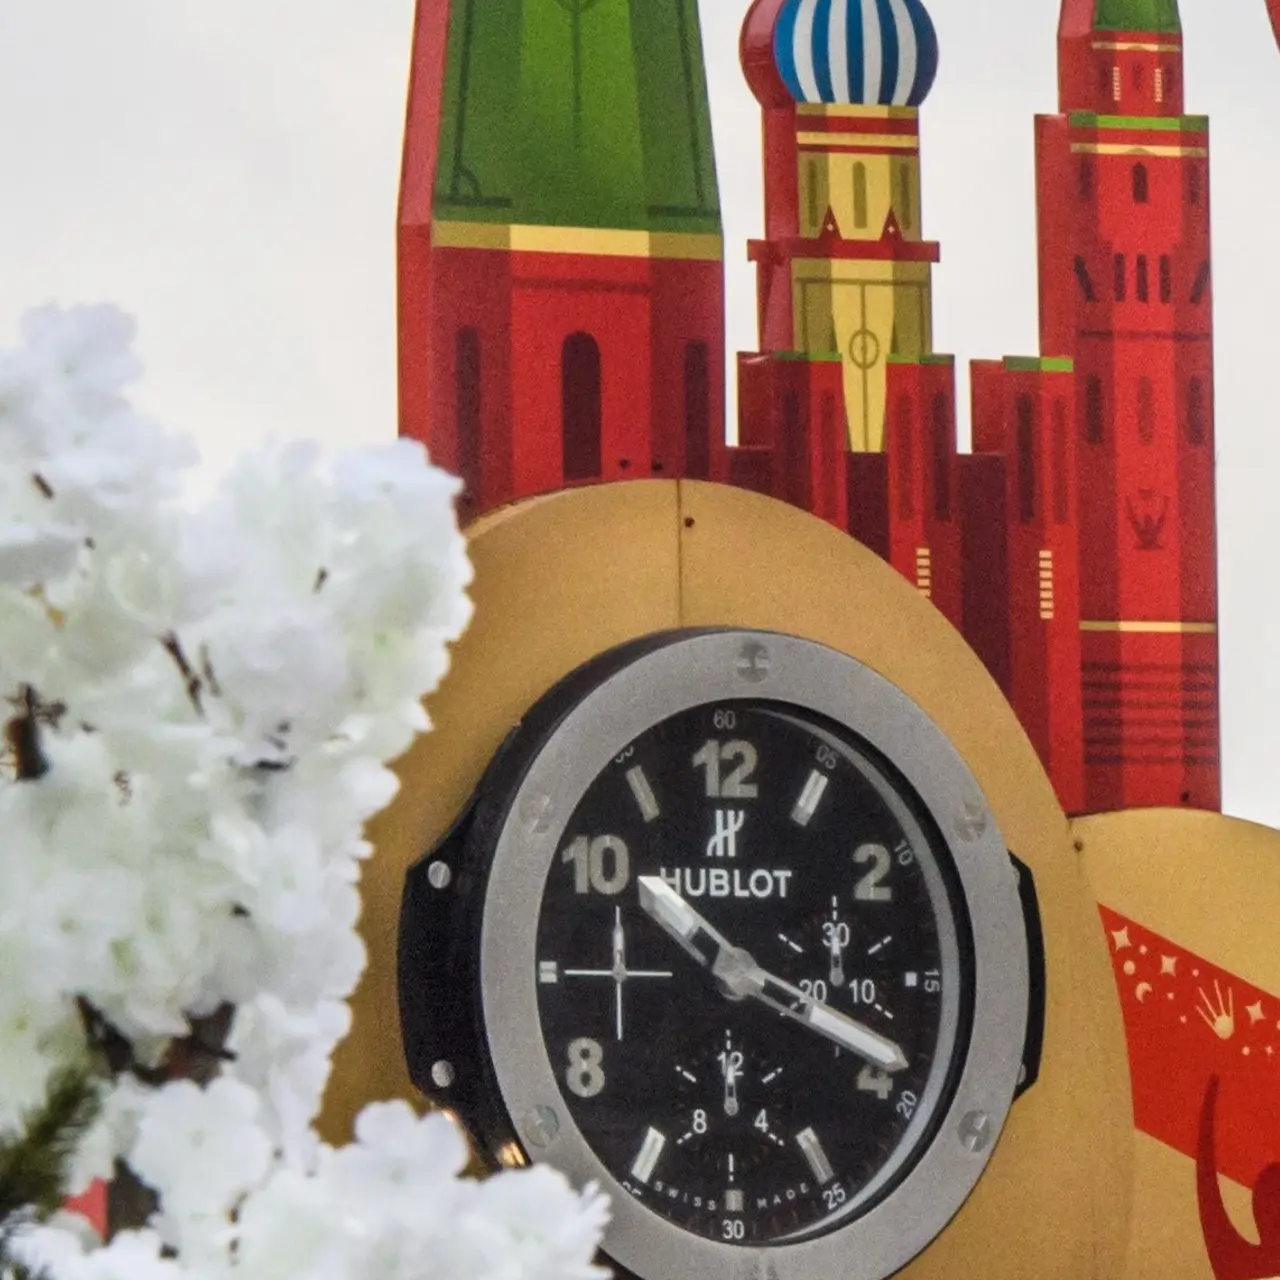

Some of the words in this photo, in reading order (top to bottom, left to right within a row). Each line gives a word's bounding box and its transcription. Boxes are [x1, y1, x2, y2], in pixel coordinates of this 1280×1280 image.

[712, 709, 736, 730] 60
[691, 739, 759, 799] 12
[561, 834, 630, 896] 10
[852, 842, 893, 901] 2
[660, 867, 793, 899] HUBLOT
[821, 921, 851, 949] 30
[848, 978, 876, 1005] 10
[923, 969, 941, 993] 15
[565, 1036, 606, 1099] 8
[895, 1090, 917, 1119] 20
[692, 1108, 708, 1134] 8
[753, 1108, 769, 1134] 4
[653, 1180, 717, 1211] SWISS
[756, 1181, 810, 1210] MADE
[822, 1182, 846, 1210] 25
[722, 1219, 745, 1241] 30
